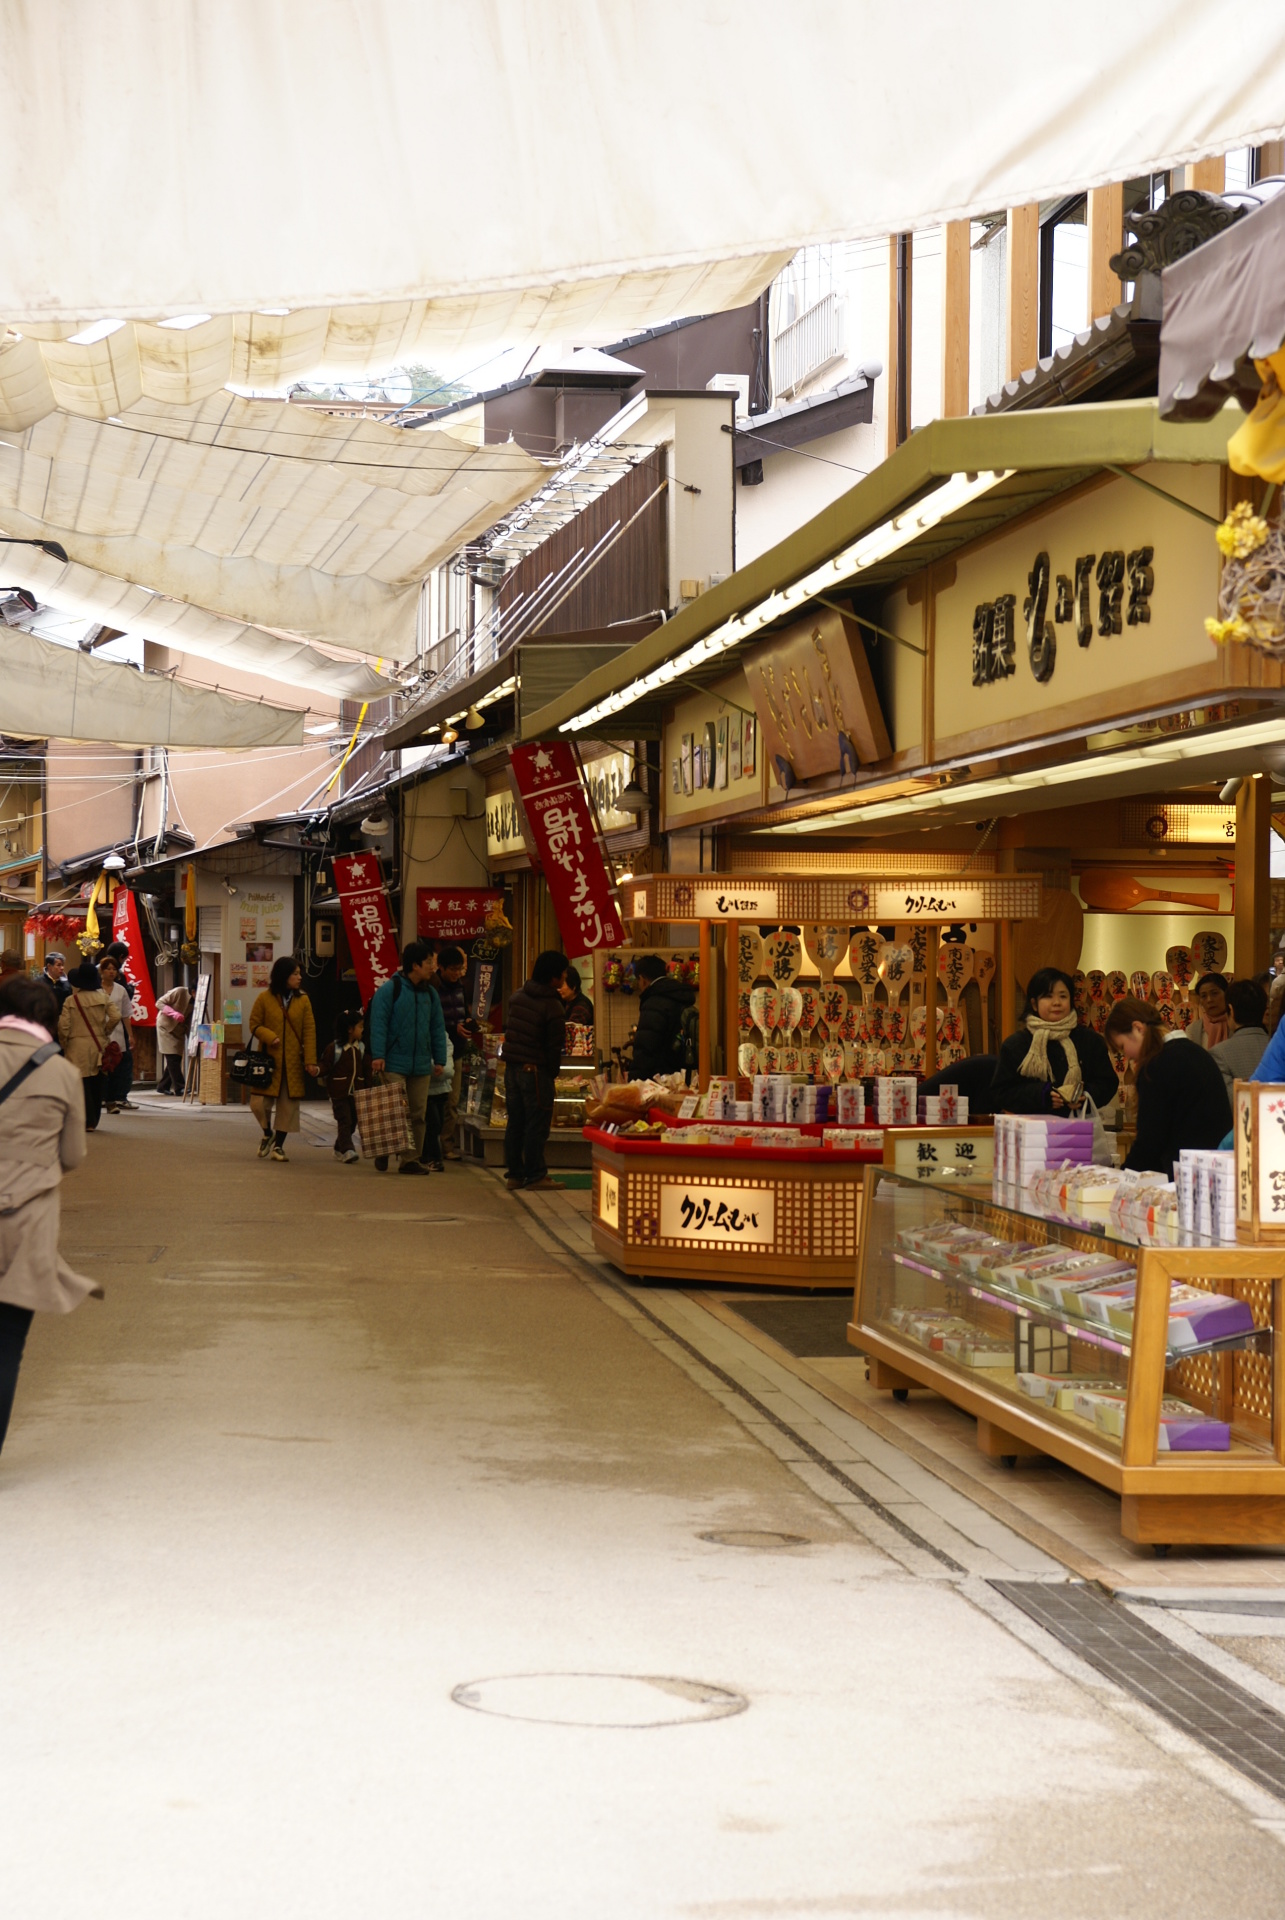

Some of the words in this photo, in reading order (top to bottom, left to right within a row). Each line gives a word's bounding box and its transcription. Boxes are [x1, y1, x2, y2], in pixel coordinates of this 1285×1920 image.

[905, 895, 956, 913] クリームもみじ
[428, 919, 466, 929] ここだけの
[769, 940, 795, 981] 必勝
[1201, 935, 1219, 972] 家内安
[252, 1066, 265, 1075] 13
[680, 1194, 759, 1232] クリームもみじ
